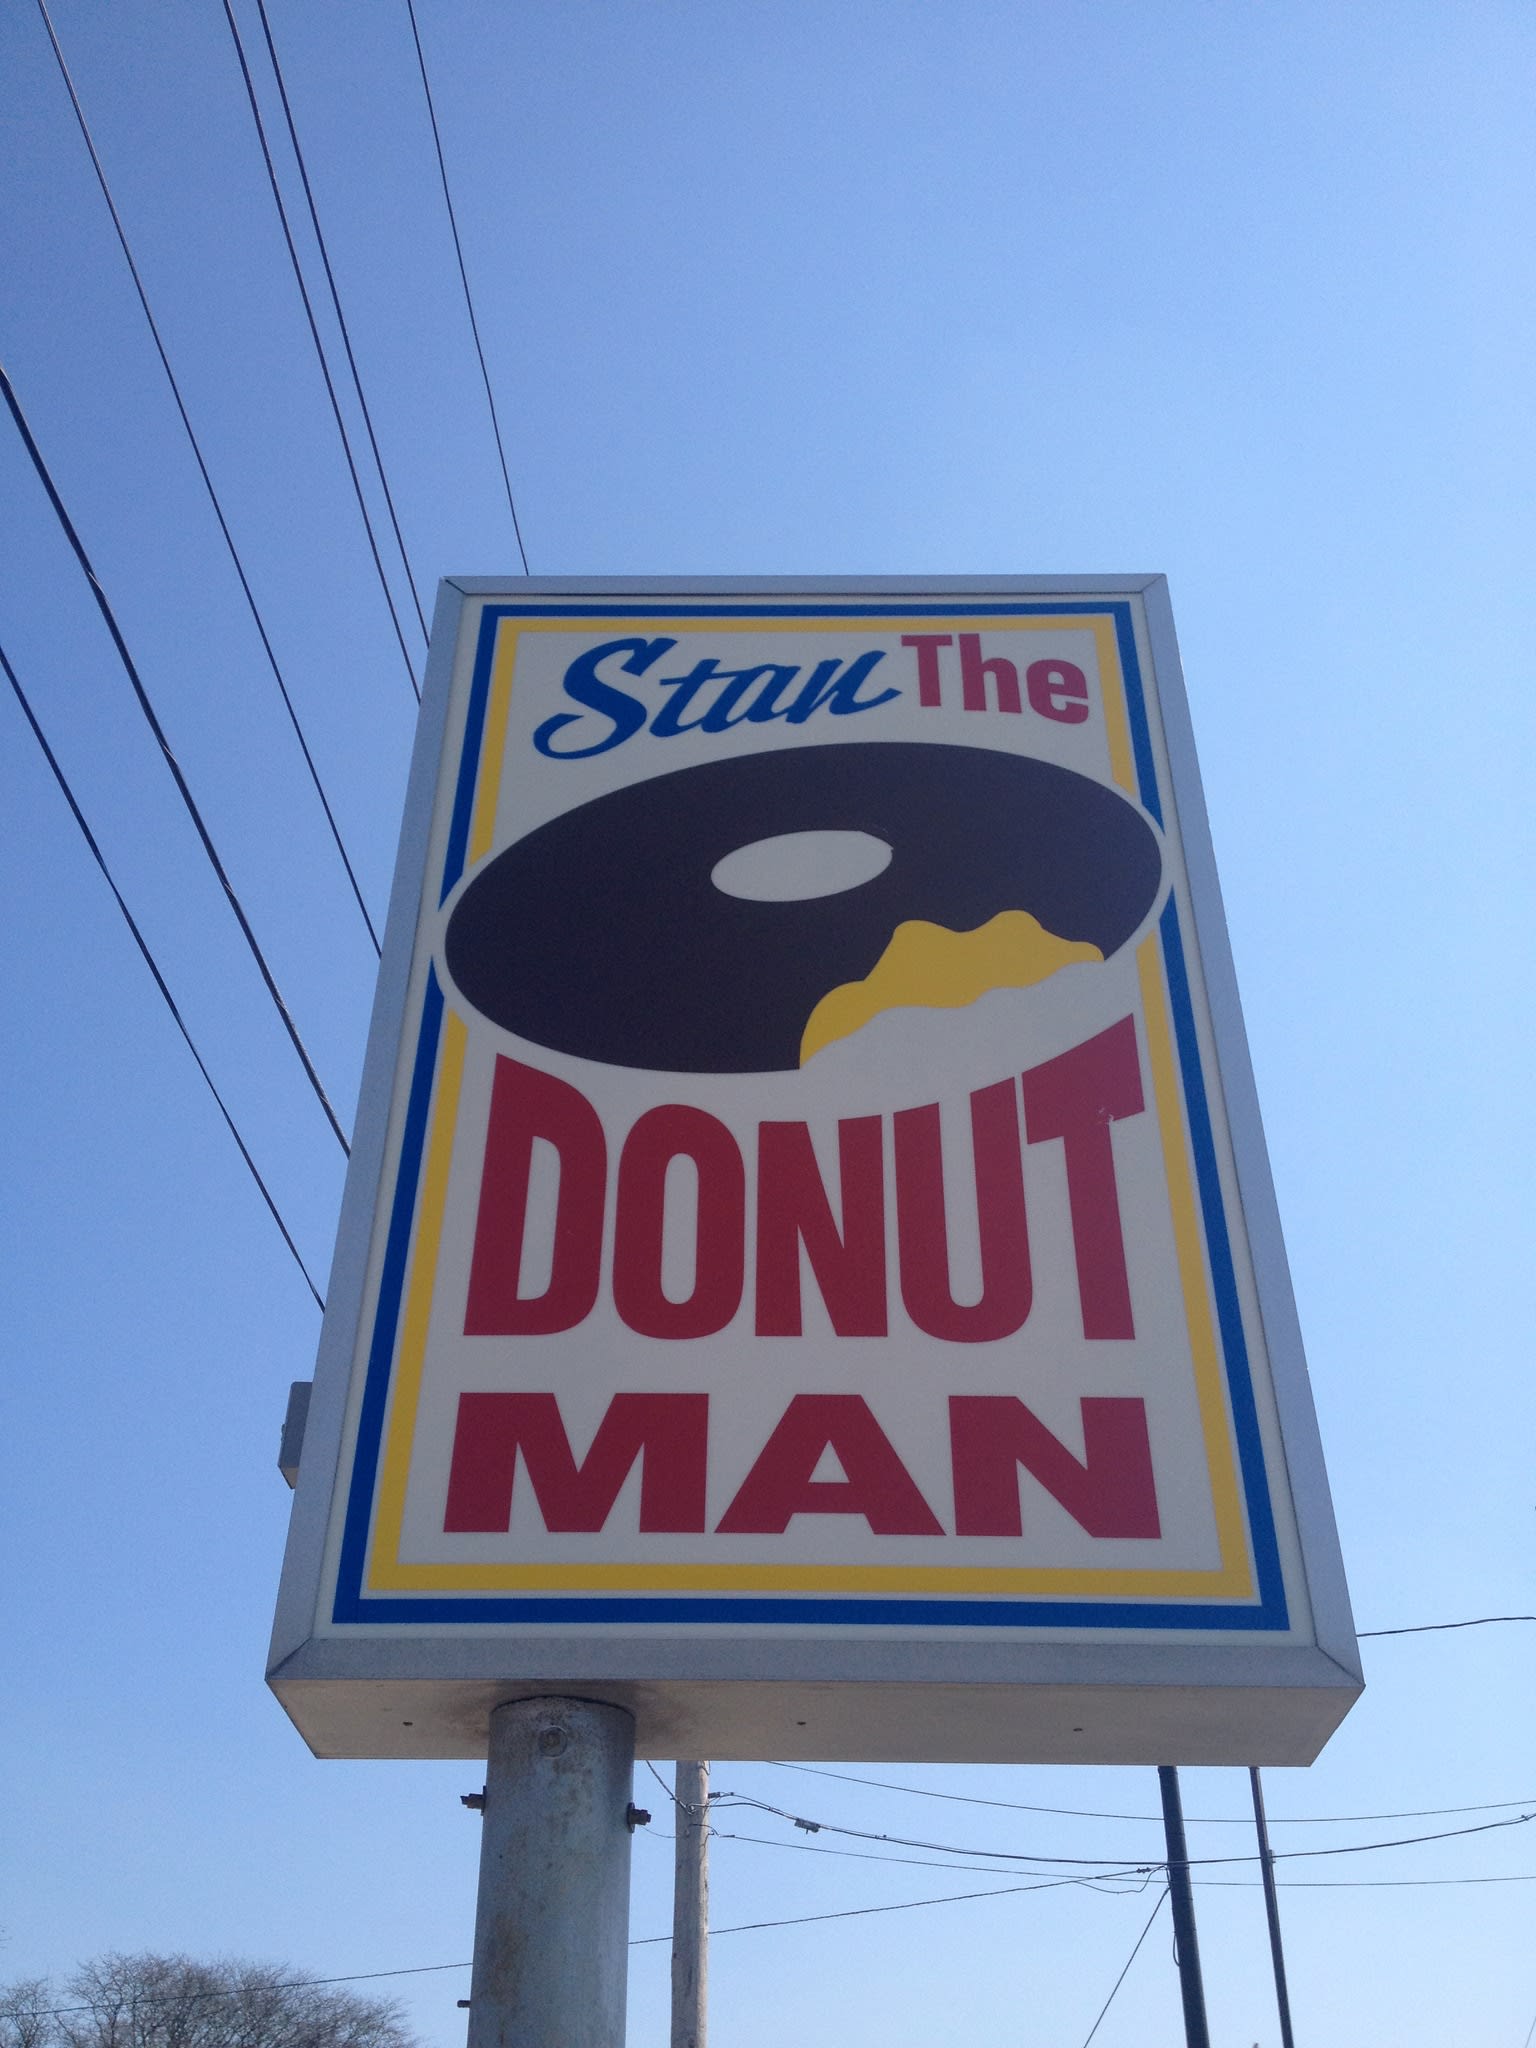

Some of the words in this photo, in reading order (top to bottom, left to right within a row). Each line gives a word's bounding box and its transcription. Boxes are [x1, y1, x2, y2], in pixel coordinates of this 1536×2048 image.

[533, 637, 903, 760] Stan
[902, 633, 1088, 724] The
[464, 1014, 1146, 1342] DONUT
[444, 1393, 1160, 1538] MAN
